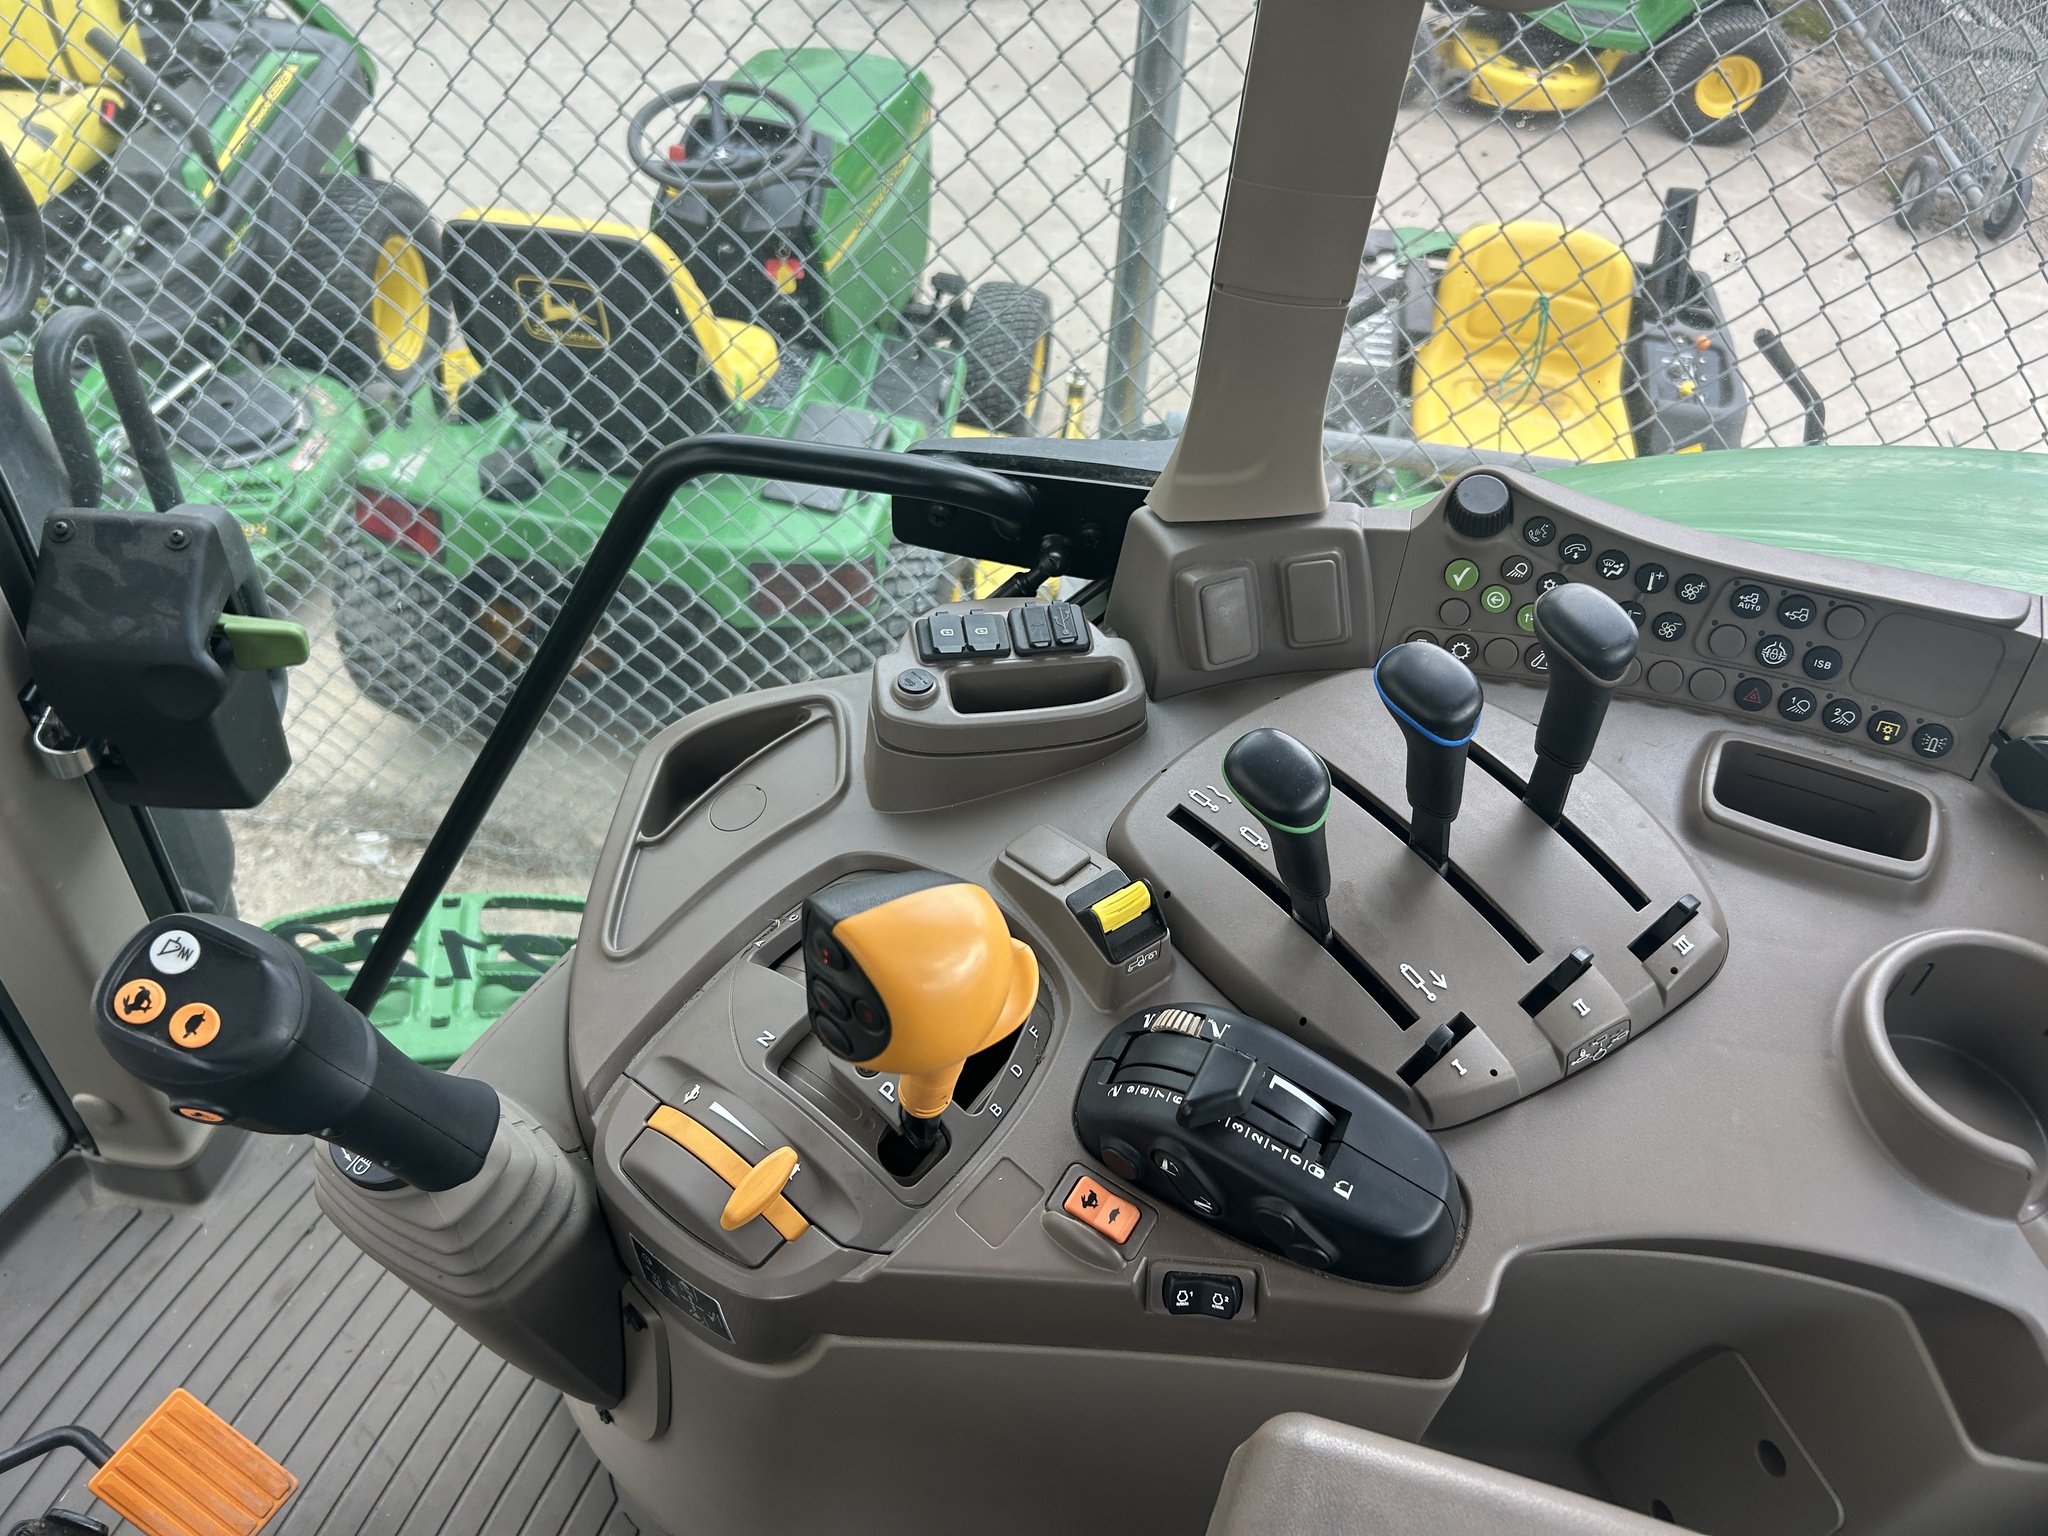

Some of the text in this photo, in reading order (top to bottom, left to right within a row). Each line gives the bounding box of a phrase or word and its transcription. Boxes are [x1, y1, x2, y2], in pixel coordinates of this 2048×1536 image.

[1737, 601, 1761, 612] AUTO
[1813, 659, 1832, 670] ISB
[1791, 696, 1797, 704] 1
[1833, 707, 1842, 716] 2
[788, 914, 799, 923] C
[754, 939, 766, 948] A
[1672, 934, 1694, 956] III
[1572, 998, 1591, 1017] II
[756, 1030, 777, 1048] N
[1029, 1025, 1040, 1039] F
[1010, 1063, 1024, 1078] D
[1450, 1058, 1468, 1076] I
[878, 1081, 896, 1104] P
[989, 1102, 1003, 1118] B
[1139, 1087, 1150, 1096] 8
[1154, 1089, 1165, 1099] 7
[1231, 1122, 1244, 1133] 3
[1251, 1132, 1264, 1145] 2
[1270, 1143, 1283, 1153] 1
[1289, 1153, 1303, 1166] 0
